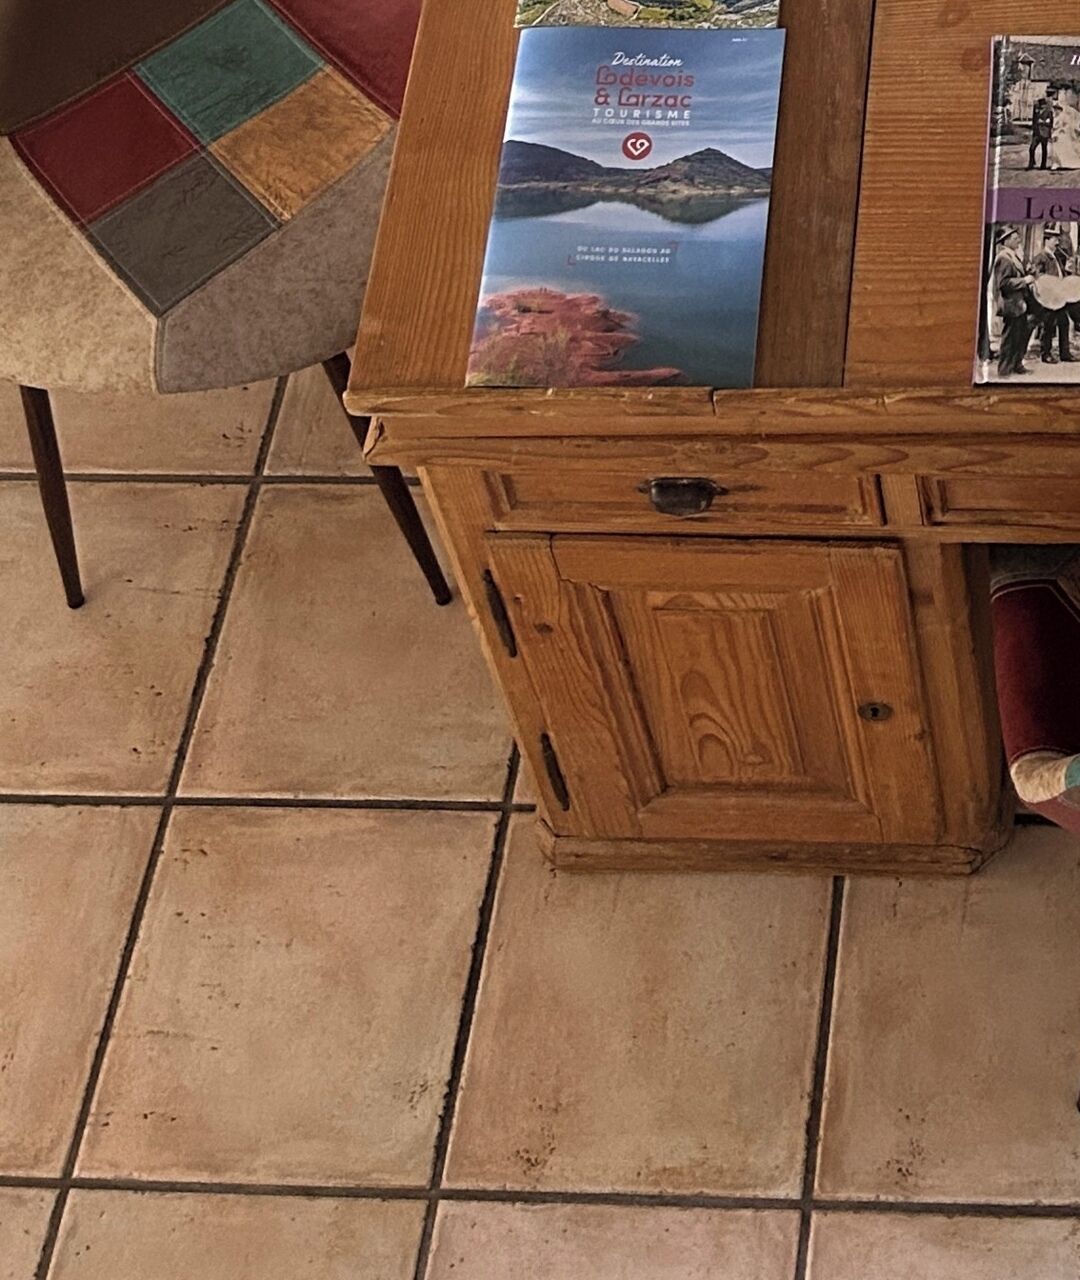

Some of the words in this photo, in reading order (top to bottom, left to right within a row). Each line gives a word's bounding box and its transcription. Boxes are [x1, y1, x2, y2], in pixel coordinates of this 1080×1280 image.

[611, 51, 684, 68] Destination
[595, 64, 695, 88] Lodévois
[593, 87, 610, 107] &
[617, 86, 692, 108] Larzac
[592, 107, 692, 120] TOURISME
[1024, 196, 1080, 220] Les
